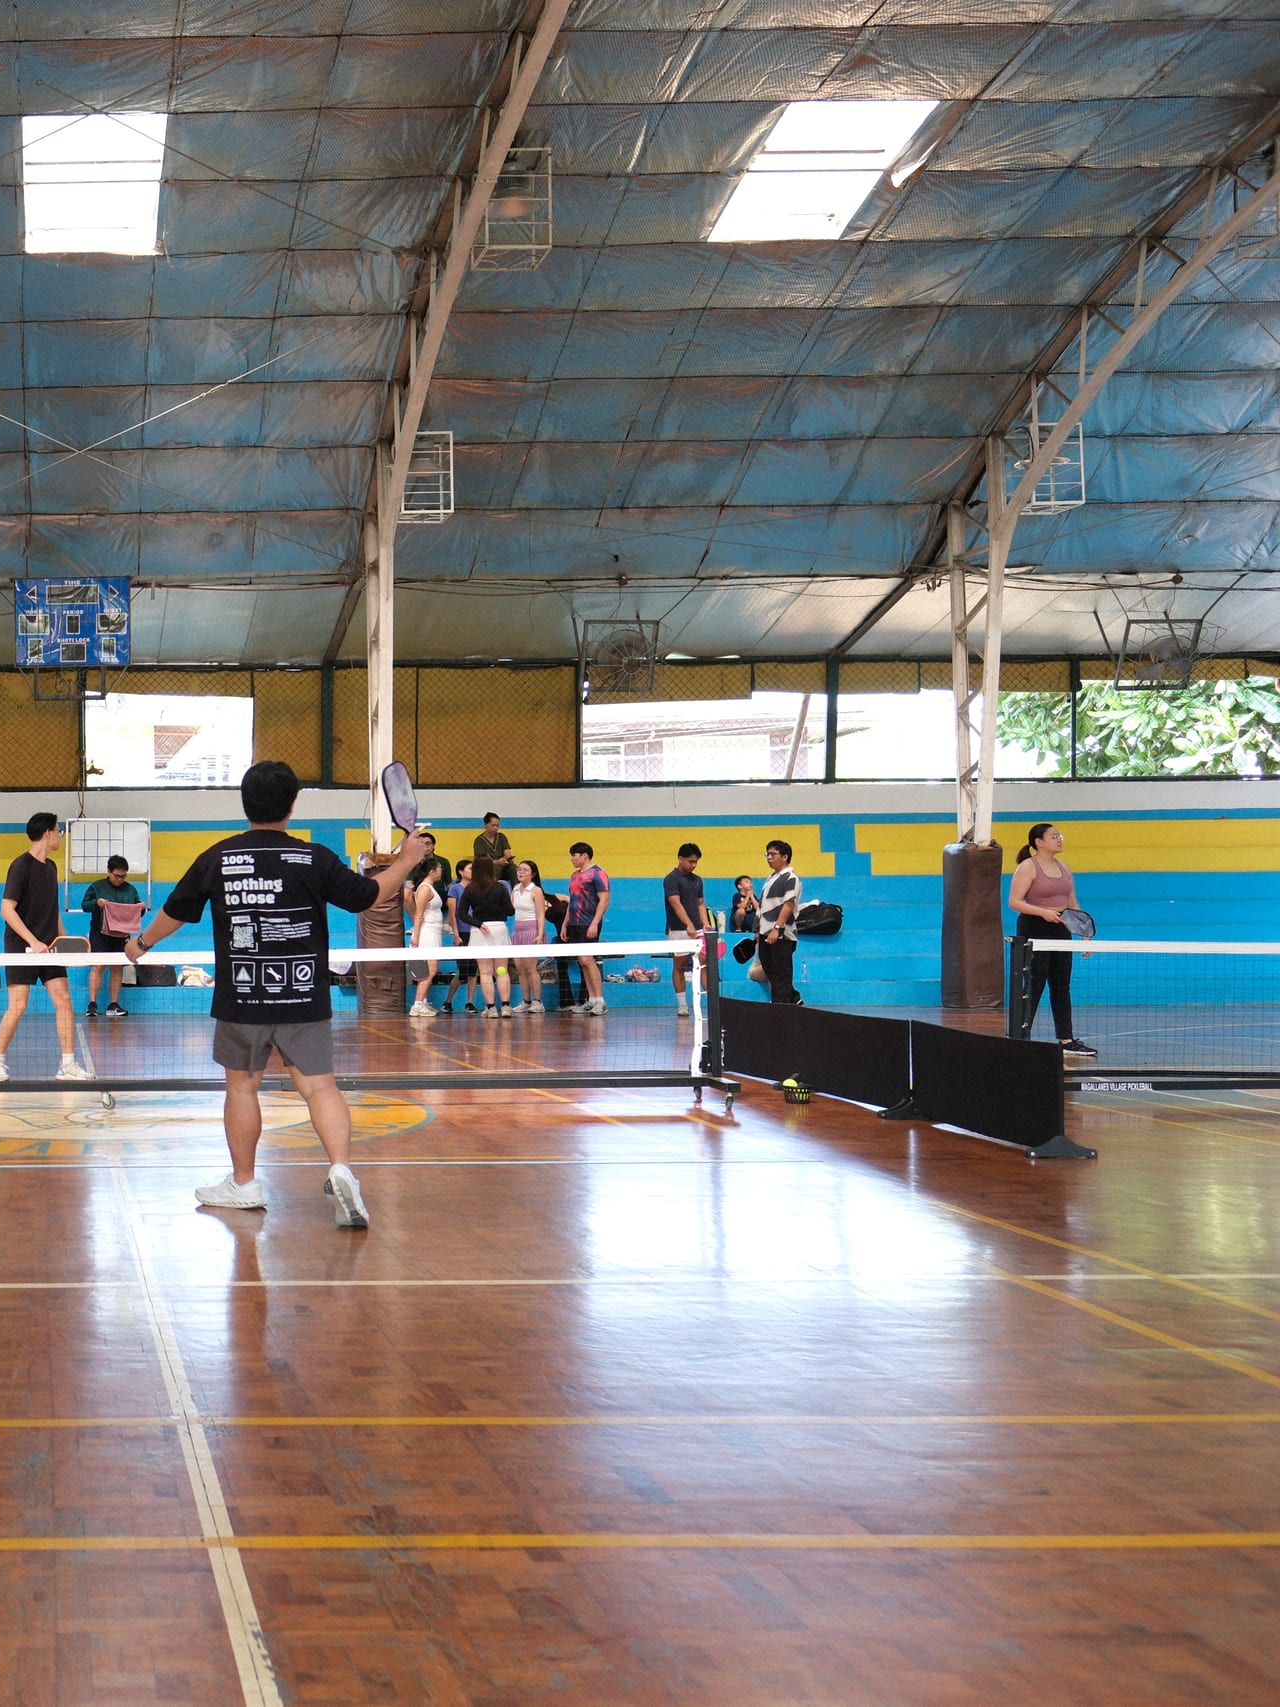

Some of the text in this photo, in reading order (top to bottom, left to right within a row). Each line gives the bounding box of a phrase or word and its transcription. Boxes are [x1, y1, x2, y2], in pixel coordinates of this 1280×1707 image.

[222, 855, 255, 865] 100%
[224, 878, 283, 893] nothing
[225, 891, 276, 906] to lose
[1110, 1082, 1127, 1091] VILLAGE
[1128, 1082, 1153, 1091] PICKLEBALL
